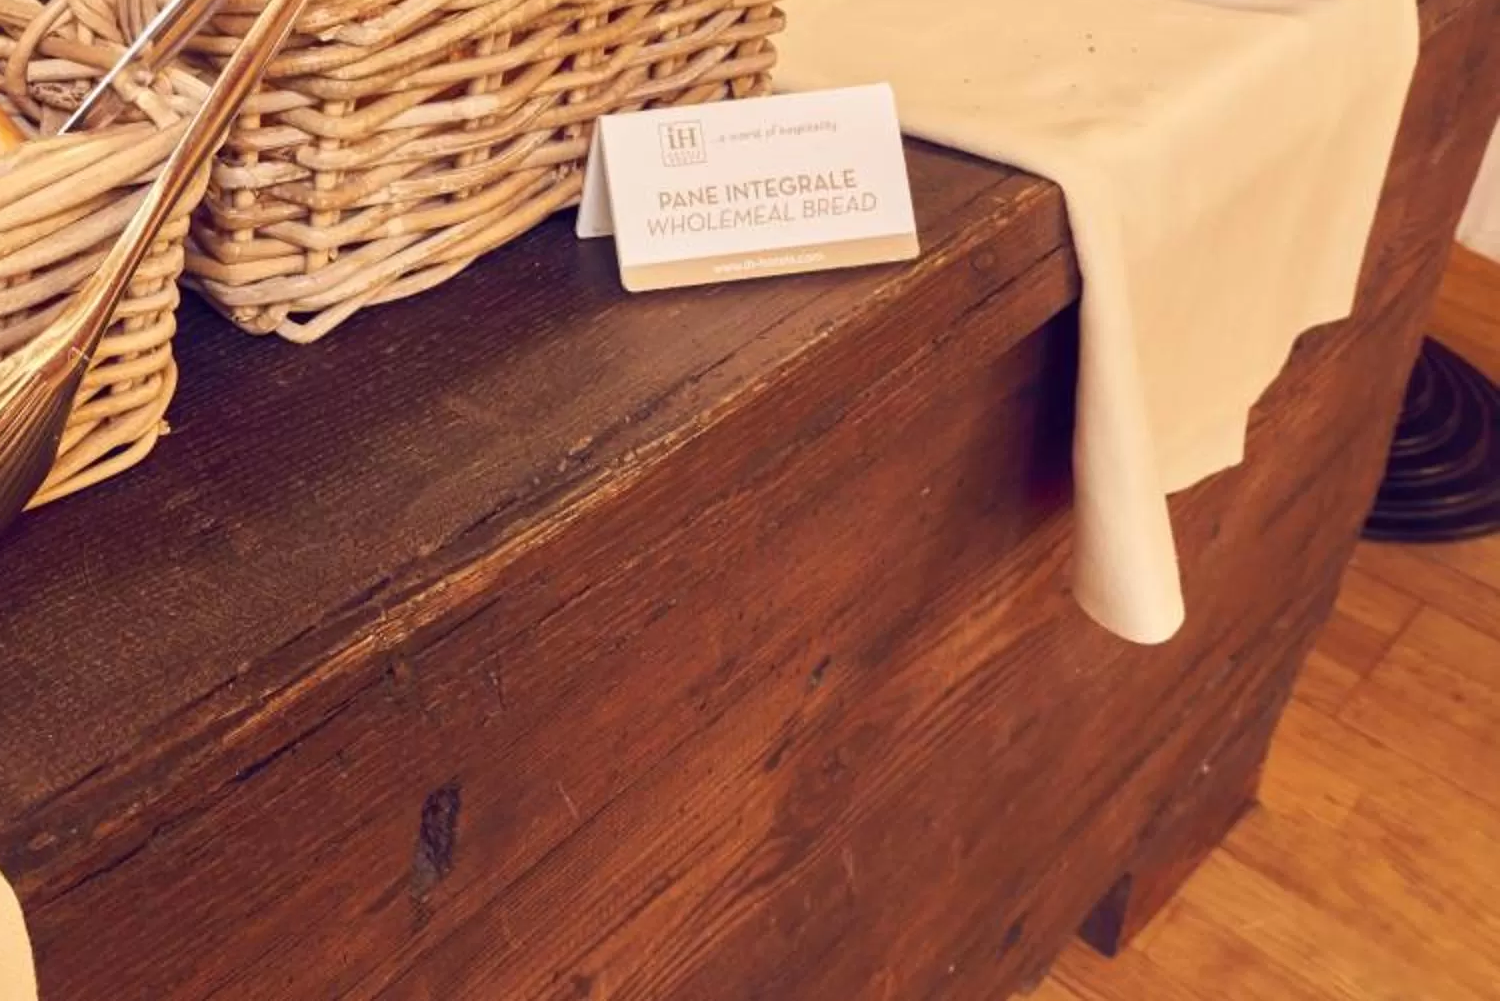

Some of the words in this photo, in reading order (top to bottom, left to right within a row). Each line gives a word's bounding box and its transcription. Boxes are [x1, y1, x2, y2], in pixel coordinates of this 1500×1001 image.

[658, 185, 718, 211] PANE
[725, 169, 858, 203] INTEGRALE
[646, 203, 796, 239] WHOLEMEAL
[802, 191, 879, 220] BREAD
